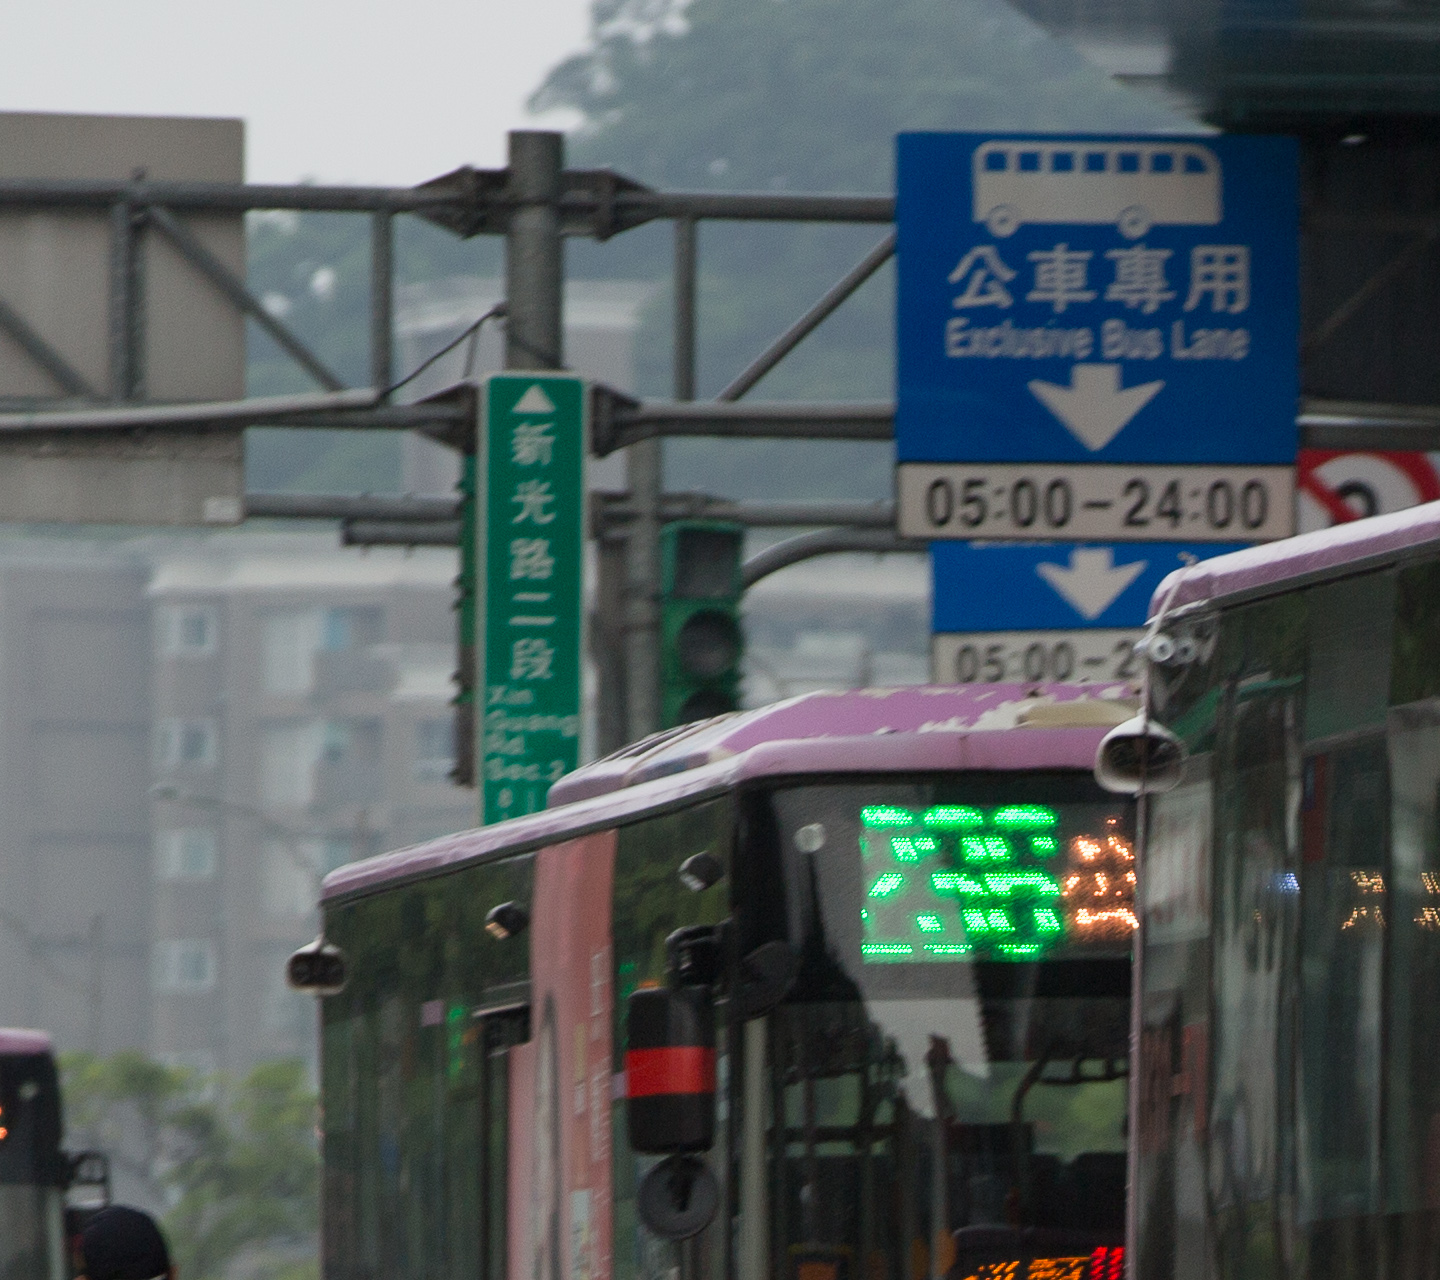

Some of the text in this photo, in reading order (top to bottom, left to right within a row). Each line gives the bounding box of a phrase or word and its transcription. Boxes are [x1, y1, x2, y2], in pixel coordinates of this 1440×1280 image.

[948, 244, 1252, 314] 公車專用
[944, 317, 1252, 360] Exclusive Bus Lane
[509, 421, 557, 680] 新光路二段
